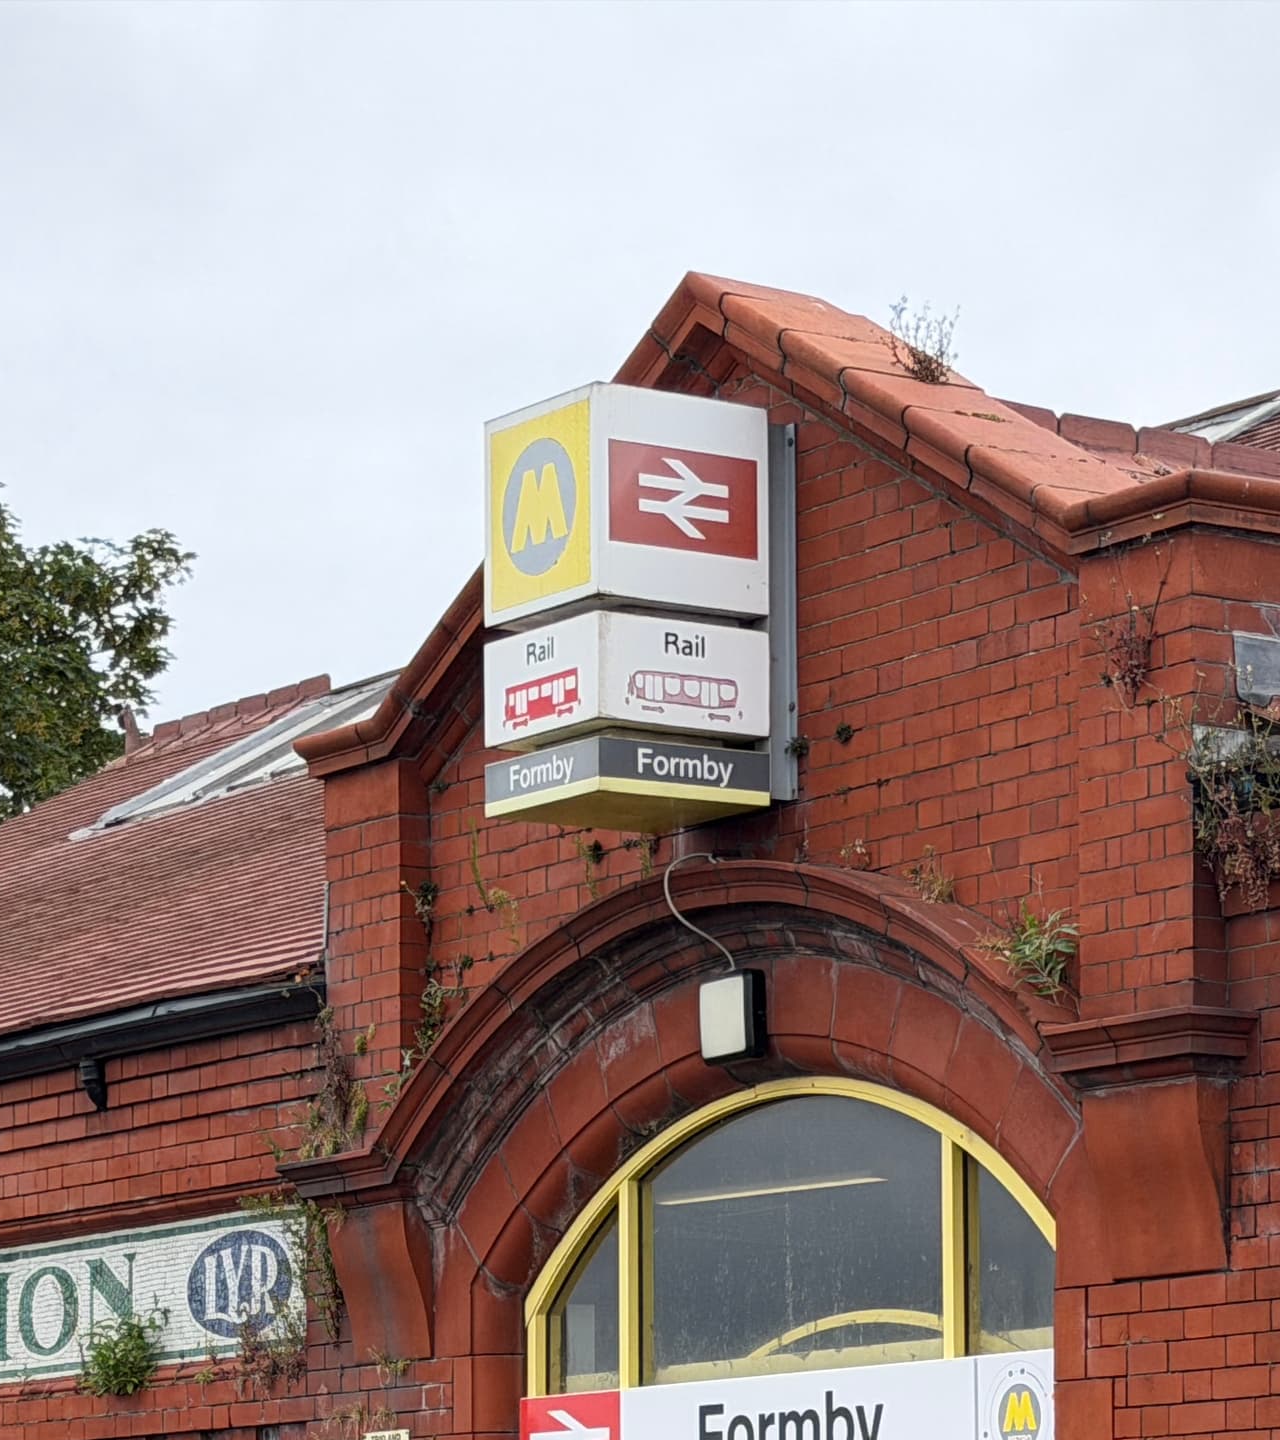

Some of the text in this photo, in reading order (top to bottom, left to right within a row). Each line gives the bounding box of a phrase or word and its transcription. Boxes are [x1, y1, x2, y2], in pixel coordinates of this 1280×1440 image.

[510, 463, 569, 554] M
[526, 637, 554, 665] Rail
[664, 632, 705, 658] Rail
[509, 755, 574, 792] Formby
[637, 748, 733, 787] Formby
[203, 1244, 278, 1324] LYR
[1002, 1391, 1038, 1432] M
